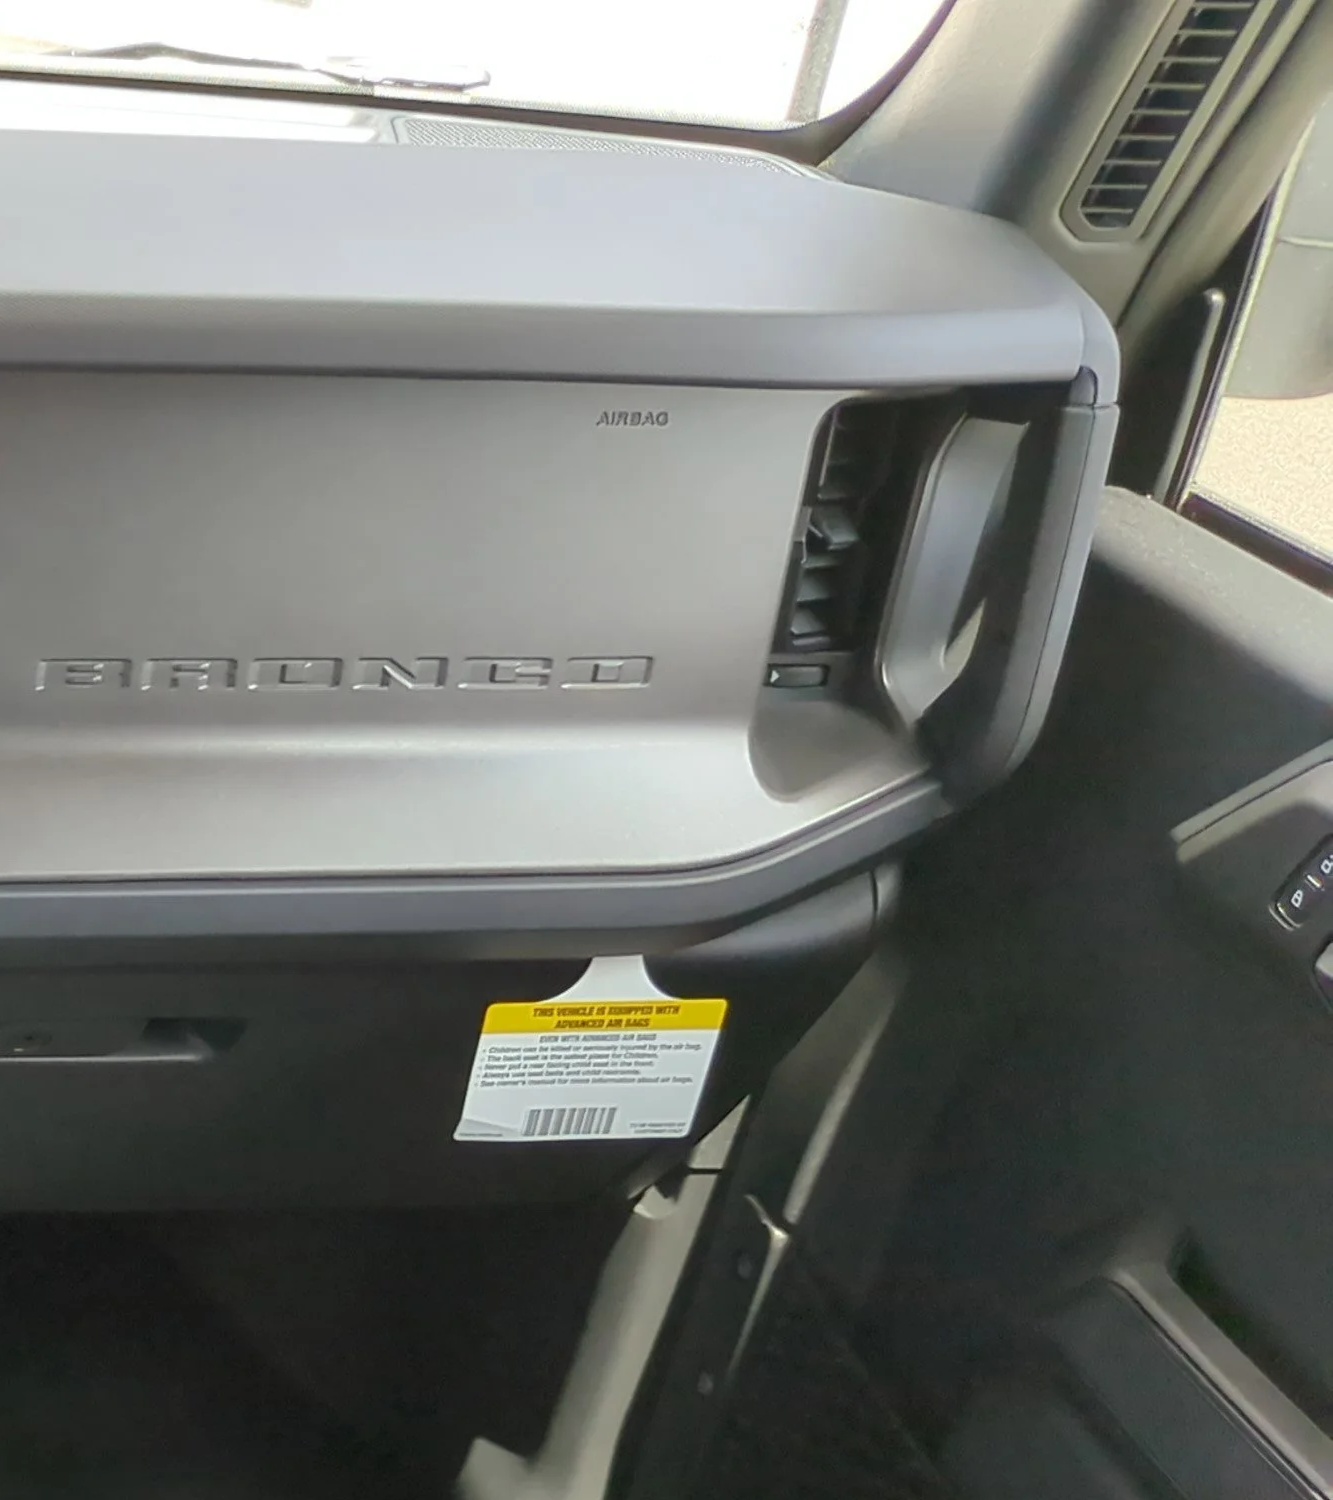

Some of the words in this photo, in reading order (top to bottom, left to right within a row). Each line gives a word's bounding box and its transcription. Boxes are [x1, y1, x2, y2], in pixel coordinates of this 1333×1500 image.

[596, 411, 669, 426] AIRBAG
[36, 658, 653, 692] BRONCO
[533, 1008, 554, 1016] THIS
[556, 1007, 594, 1016] VEHICLE
[596, 1006, 606, 1015] IS
[607, 1006, 654, 1015] EQUIPPED
[655, 1005, 681, 1014] WITH
[554, 1019, 605, 1028] ADVANCED
[606, 1019, 623, 1028] AIR
[623, 1018, 651, 1027] BAGS
